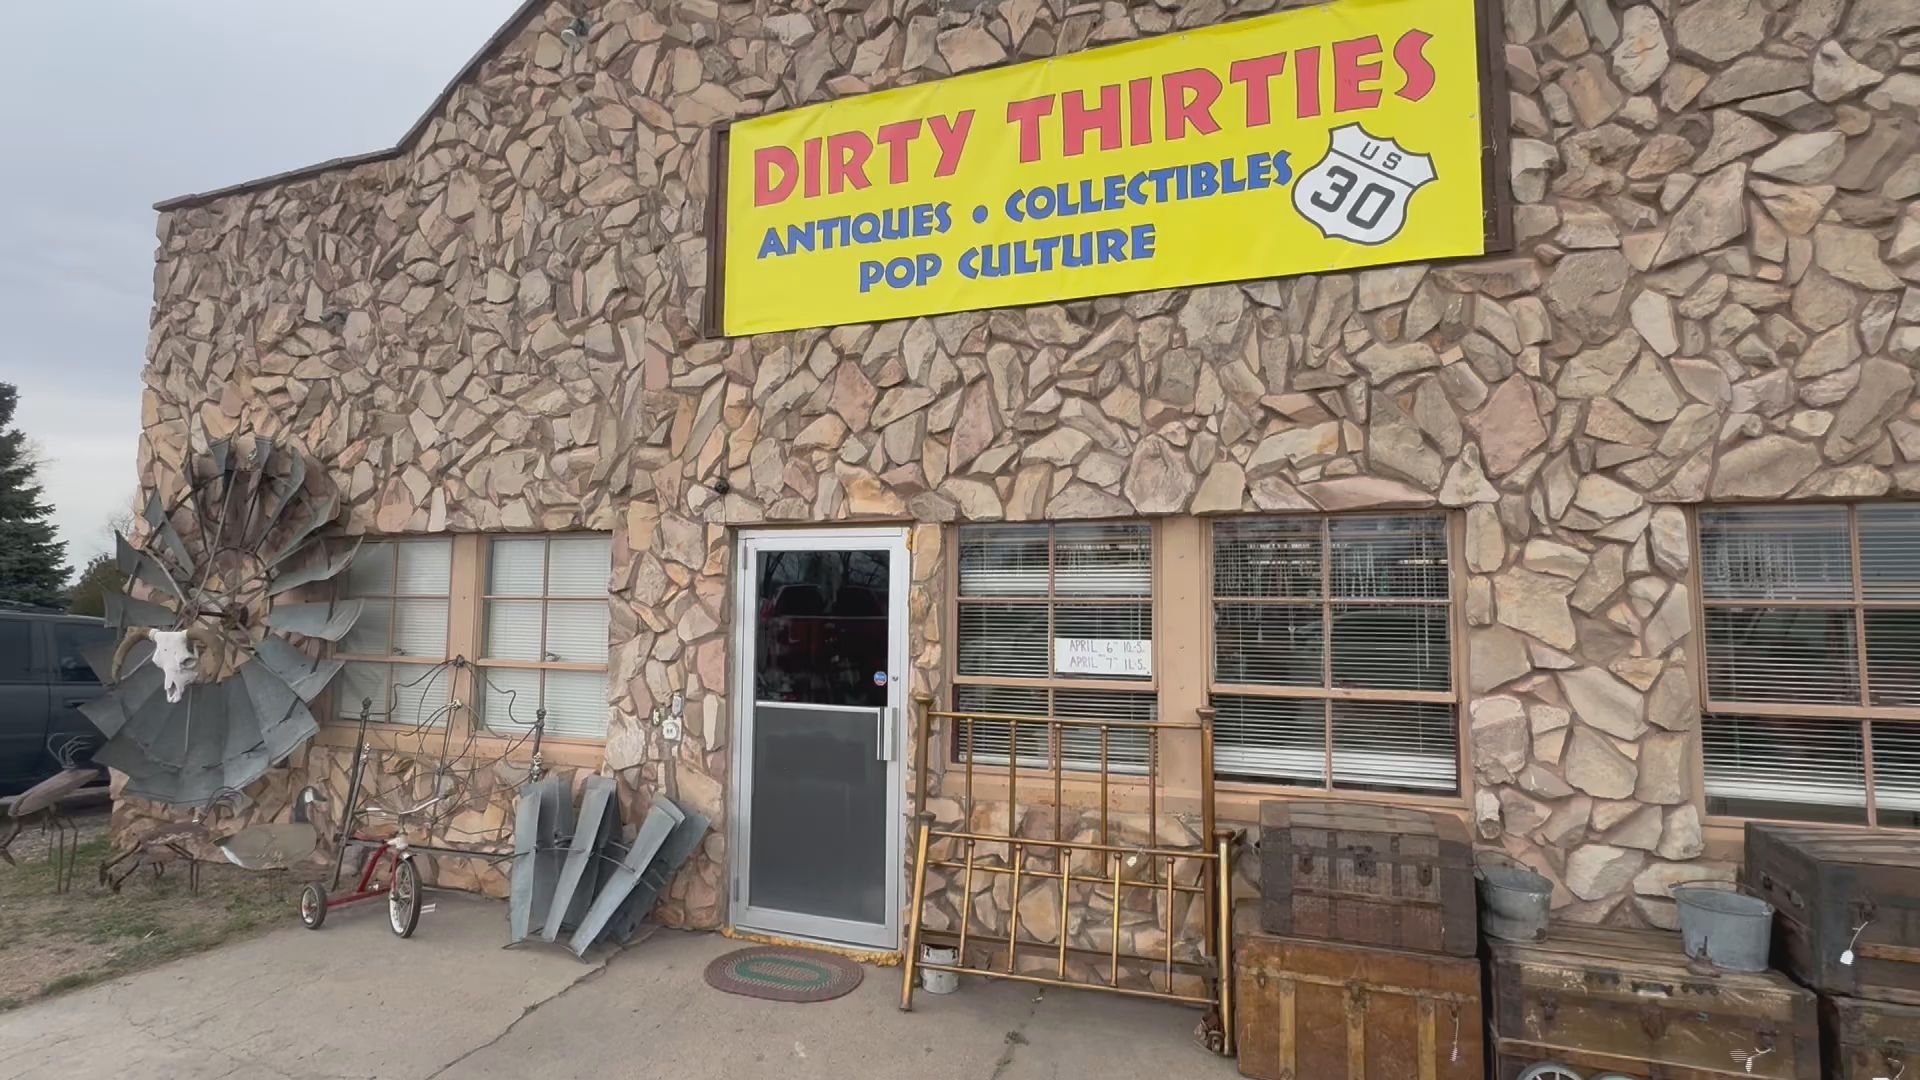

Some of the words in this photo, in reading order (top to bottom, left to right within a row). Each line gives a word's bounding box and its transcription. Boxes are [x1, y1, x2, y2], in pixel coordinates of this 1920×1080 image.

[753, 110, 975, 206] DIRTY
[1006, 28, 1435, 162] THIRTIES
[1360, 139, 1400, 171] US
[757, 202, 951, 258] ANTIQUES
[1004, 150, 1293, 223] COLLECTIBLES
[1310, 164, 1394, 230] 30
[859, 255, 942, 293] POP
[957, 223, 1156, 279] CULTURE
[1069, 639, 1097, 653] APRIL
[1070, 656, 1098, 668] APRIL
